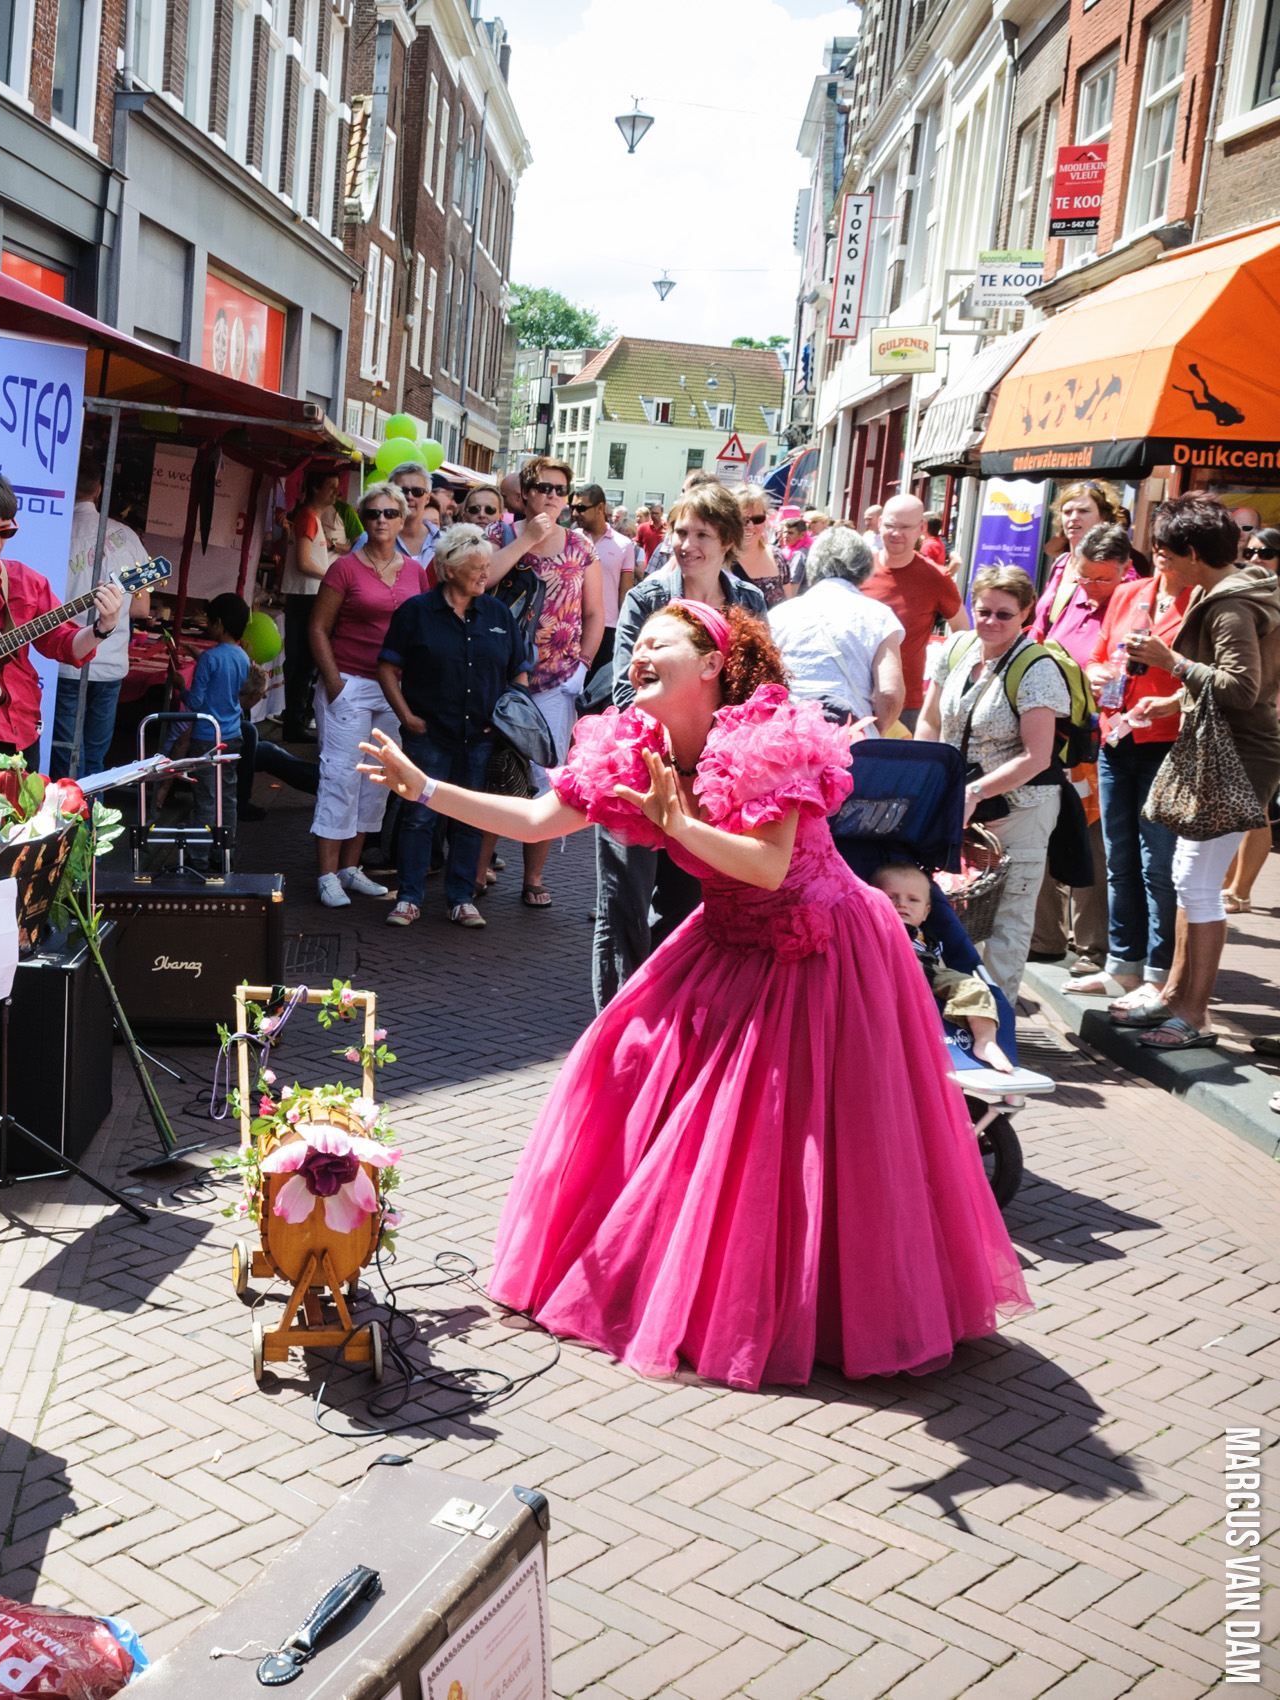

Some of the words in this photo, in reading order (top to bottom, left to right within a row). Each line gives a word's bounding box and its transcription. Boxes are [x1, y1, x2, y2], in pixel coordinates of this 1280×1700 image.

[1070, 171, 1099, 180] VLEUT
[1056, 196, 1070, 209] TE
[1073, 195, 1102, 208] KOO
[847, 204, 863, 260] TOKO
[980, 274, 997, 286] TE
[839, 274, 855, 329] NINA
[878, 337, 929, 355] GULPENER
[0, 375, 72, 475] STEP
[1013, 446, 1093, 471] onderwaterwereld
[151, 955, 202, 978] Ibanez
[22, 1626, 69, 1656] NAAR
